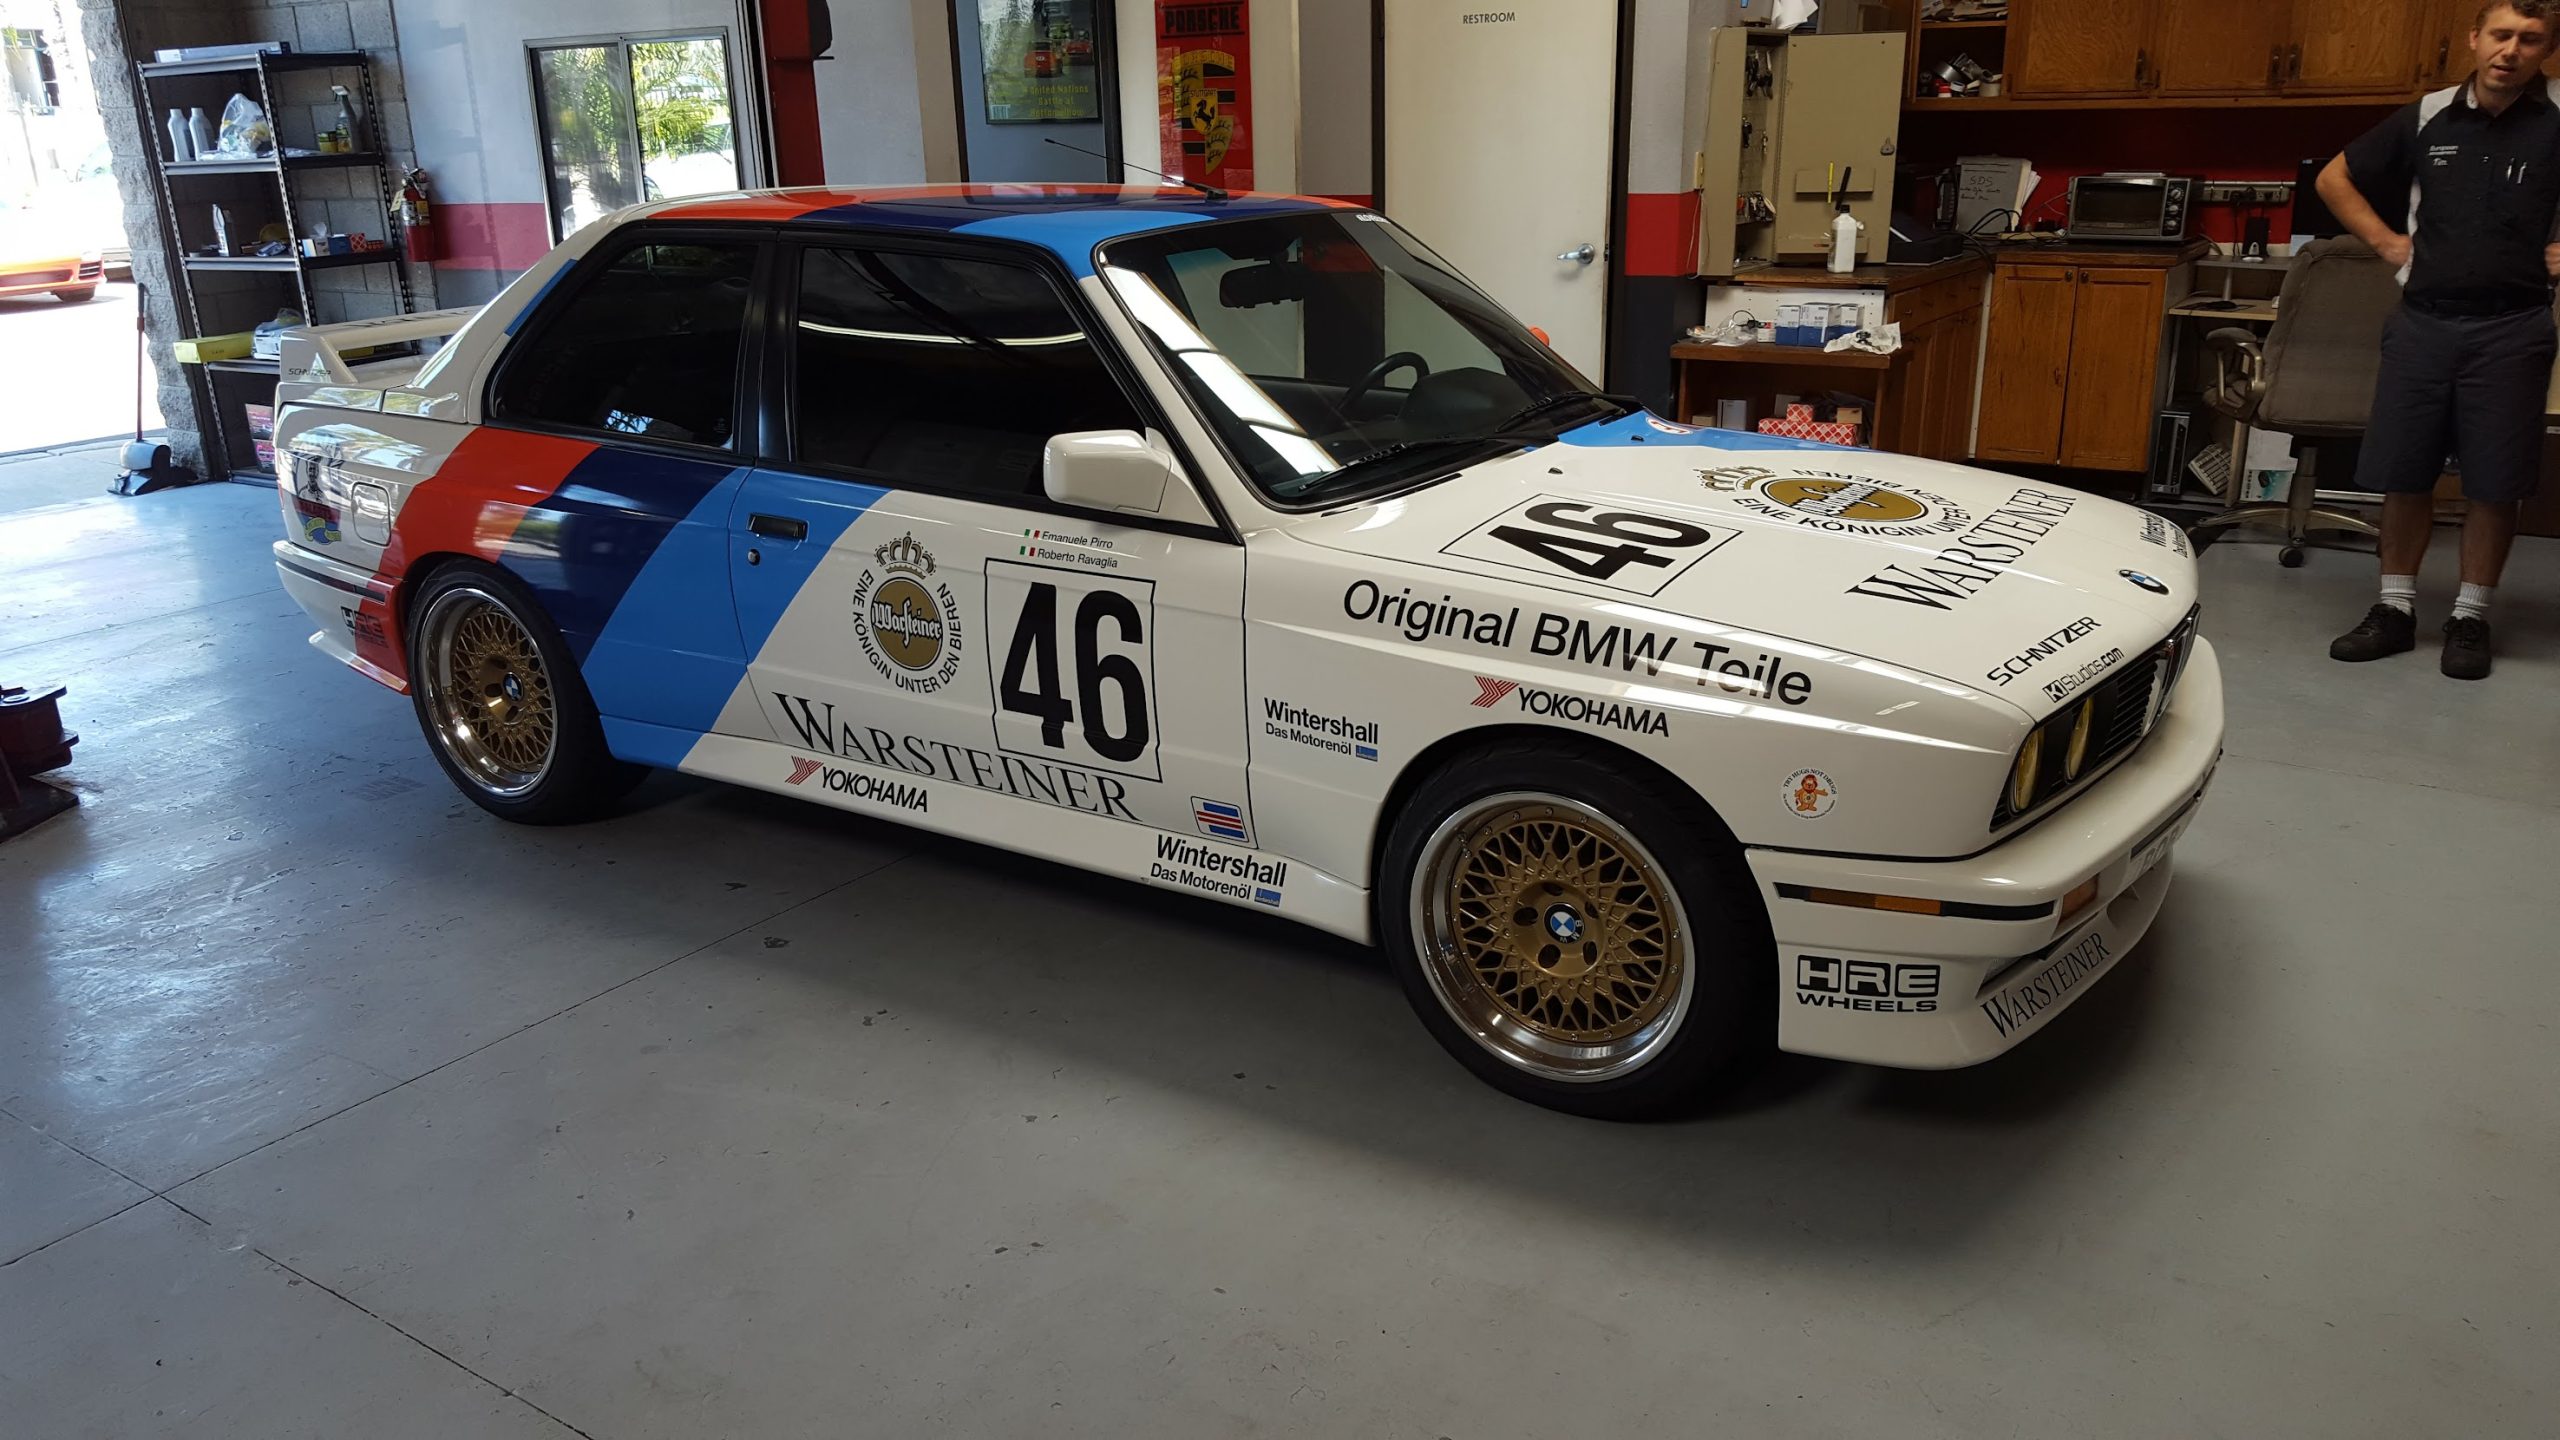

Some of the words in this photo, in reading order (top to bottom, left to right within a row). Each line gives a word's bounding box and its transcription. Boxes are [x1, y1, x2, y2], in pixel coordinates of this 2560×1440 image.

[1164, 6, 1240, 33] PORSCHE
[1462, 12, 1516, 24] RESTROOM
[1732, 497, 1796, 521] EINE
[1798, 517, 1936, 536] KÖNIGIN
[1037, 548, 1076, 563] Roberto
[1077, 553, 1118, 569] Ravaglia
[1041, 531, 1088, 546] Emanuele
[1090, 537, 1114, 549] Pirro
[1487, 501, 1711, 581] 46
[1844, 487, 2077, 611] WARSTEINER
[852, 568, 875, 609] EINE
[936, 583, 962, 652] BIEREN
[852, 611, 892, 680] KÖNIGIN
[1343, 579, 1520, 642] Original
[1530, 612, 1679, 677] BMW
[1693, 641, 1812, 706] Teile
[1986, 616, 2102, 687] SCHNITZER
[895, 673, 942, 694] UNTER
[938, 652, 960, 685] DEN
[1000, 581, 1150, 762] 46
[1263, 697, 1379, 745] Wintershall
[1518, 687, 1670, 738] YOKOHAMA
[771, 691, 1144, 823] WARSTEINER
[1265, 722, 1289, 739] Das
[1290, 728, 1352, 756] Motorenöl
[820, 765, 929, 813] YOKOHAMA
[1783, 775, 1794, 788] TRY
[1792, 768, 1810, 779] HUGS
[1810, 768, 1825, 777] NOT
[1150, 862, 1178, 882] Das
[1179, 869, 1252, 900] Motorenöl
[1157, 834, 1288, 888] Wintershall
[1797, 954, 1941, 998] HRE
[1980, 932, 2111, 1039] WARSTEINER
[1796, 991, 1938, 1013] WHEELS
